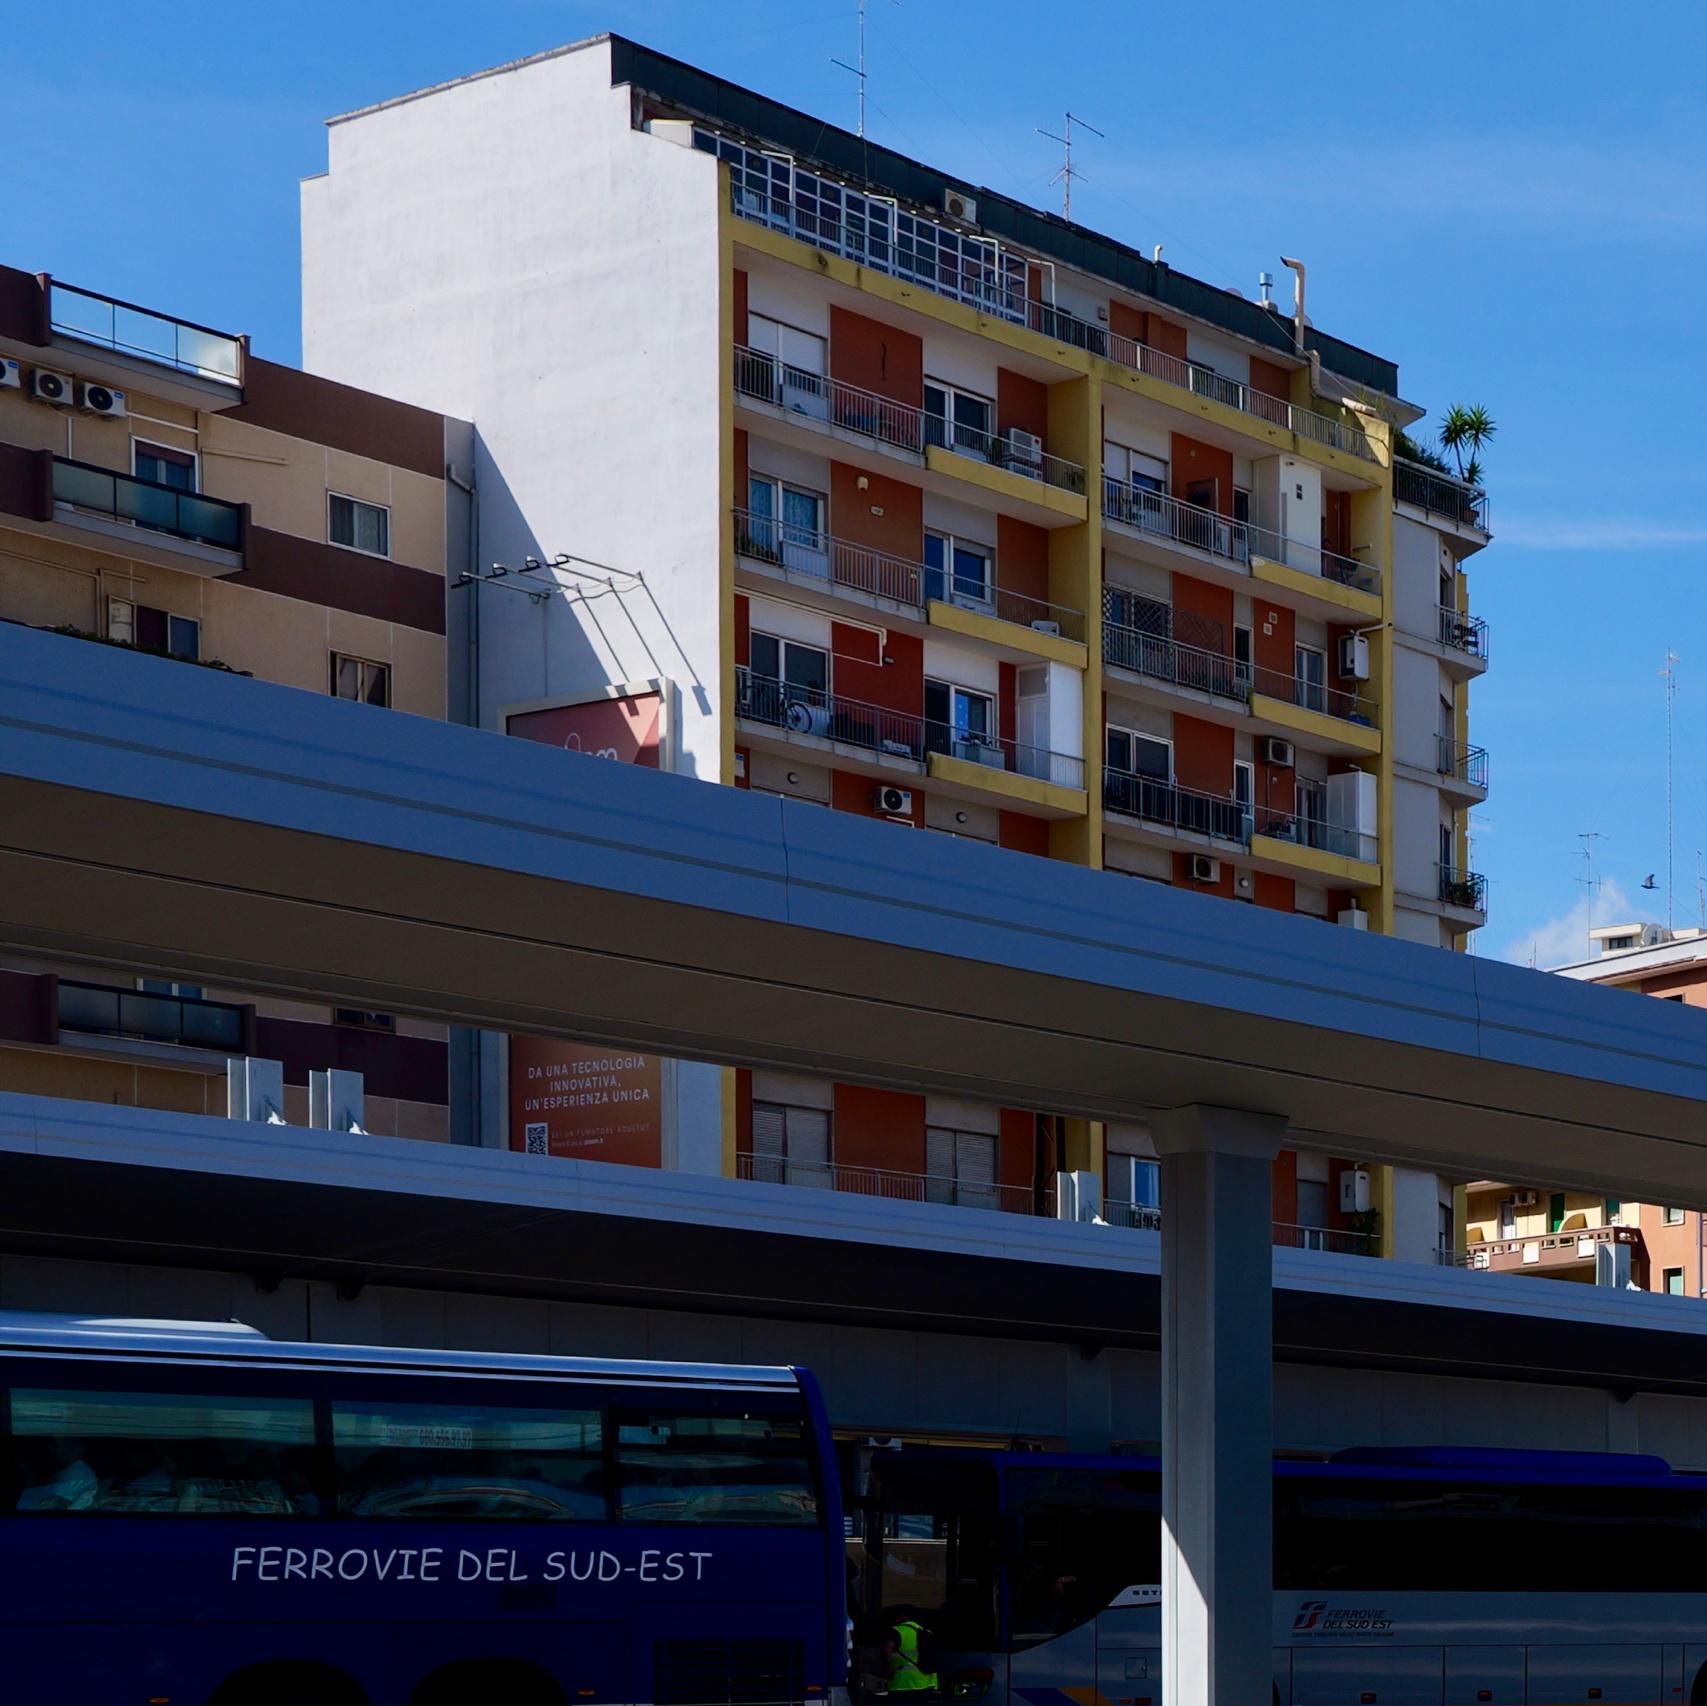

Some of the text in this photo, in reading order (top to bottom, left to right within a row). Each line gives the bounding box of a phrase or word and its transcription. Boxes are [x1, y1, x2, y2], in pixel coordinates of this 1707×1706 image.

[528, 1056, 646, 1079] DA UNA TECNOLOGIA
[550, 1075, 622, 1092] INNOVATIVA,
[525, 1088, 650, 1111] UN'ESPERIENZA UNICA
[232, 1546, 713, 1582] FERROVIE DEL SUD-EST
[1327, 1609, 1387, 1619] FERROVIE
[1322, 1620, 1394, 1629] DEL SUD EST
